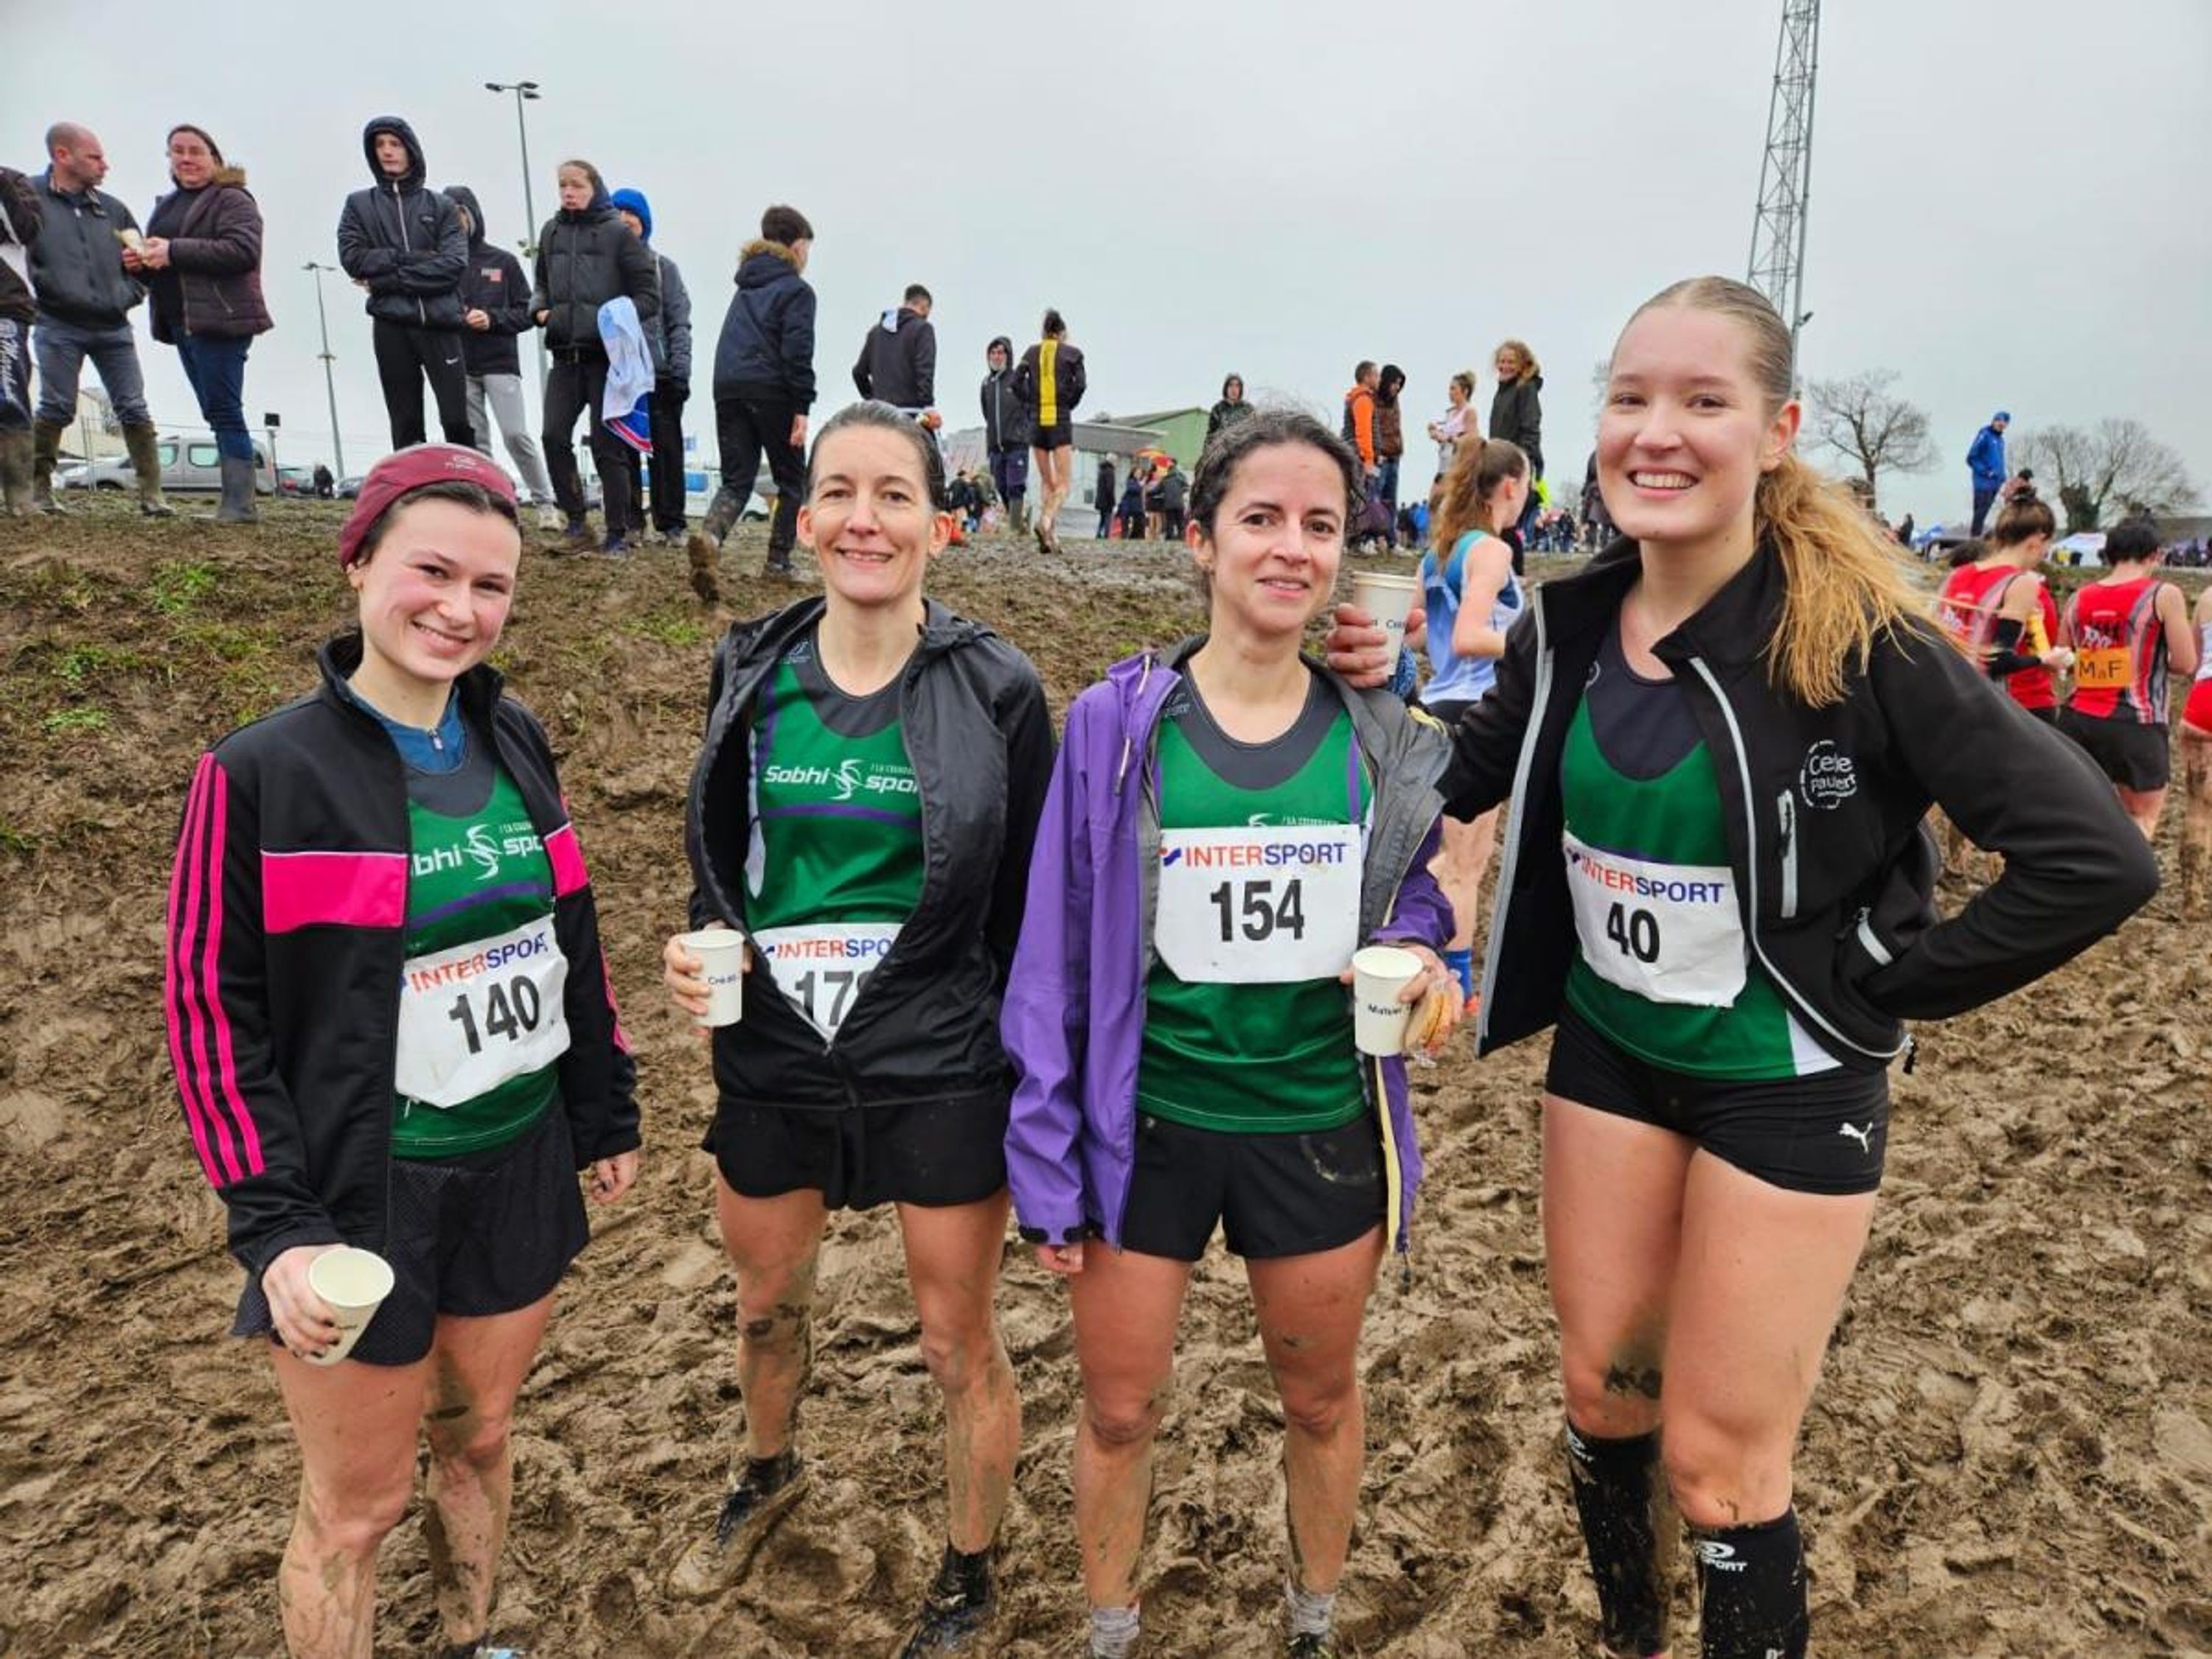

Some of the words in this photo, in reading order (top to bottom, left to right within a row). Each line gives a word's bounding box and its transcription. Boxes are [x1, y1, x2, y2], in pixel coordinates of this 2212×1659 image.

[411, 843, 463, 877] bhi
[1185, 842, 1349, 867] INTERSPORT
[1581, 855, 1725, 903] INTERSPORT
[1210, 879, 1304, 942] 154
[1607, 901, 1660, 963] 40
[448, 975, 540, 1054] 140
[794, 970, 873, 1026] 17
